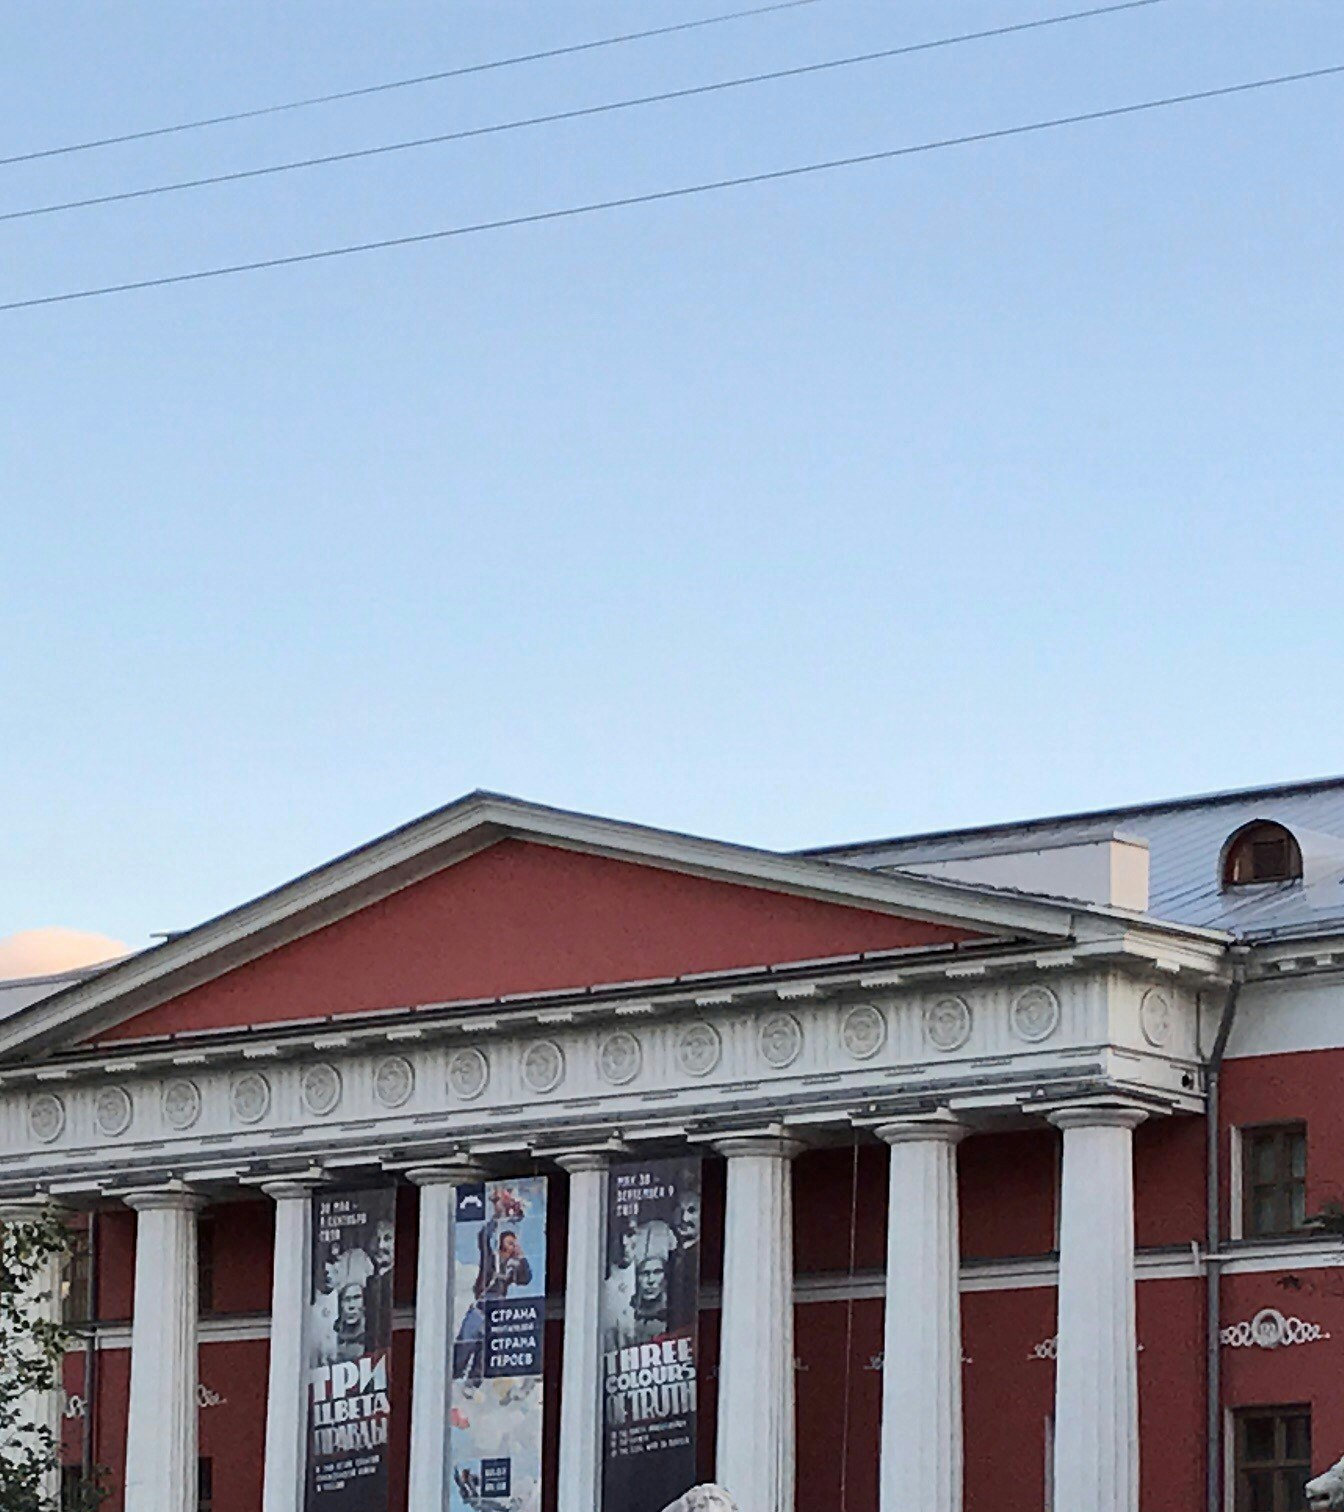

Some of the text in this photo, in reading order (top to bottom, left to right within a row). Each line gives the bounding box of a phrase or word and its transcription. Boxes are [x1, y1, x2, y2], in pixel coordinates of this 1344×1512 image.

[491, 1307, 537, 1322] СТРАНА
[490, 1353, 533, 1367] ГЕРОЕВ
[491, 1336, 536, 1351] СТРАНА
[603, 1338, 692, 1374] THREE
[310, 1355, 387, 1402] ТРИ
[606, 1362, 696, 1394] COLOURS
[315, 1392, 390, 1427] ЦВЕТА
[628, 1380, 697, 1421] TRUTH
[315, 1417, 388, 1456] ПРАВДЫ
